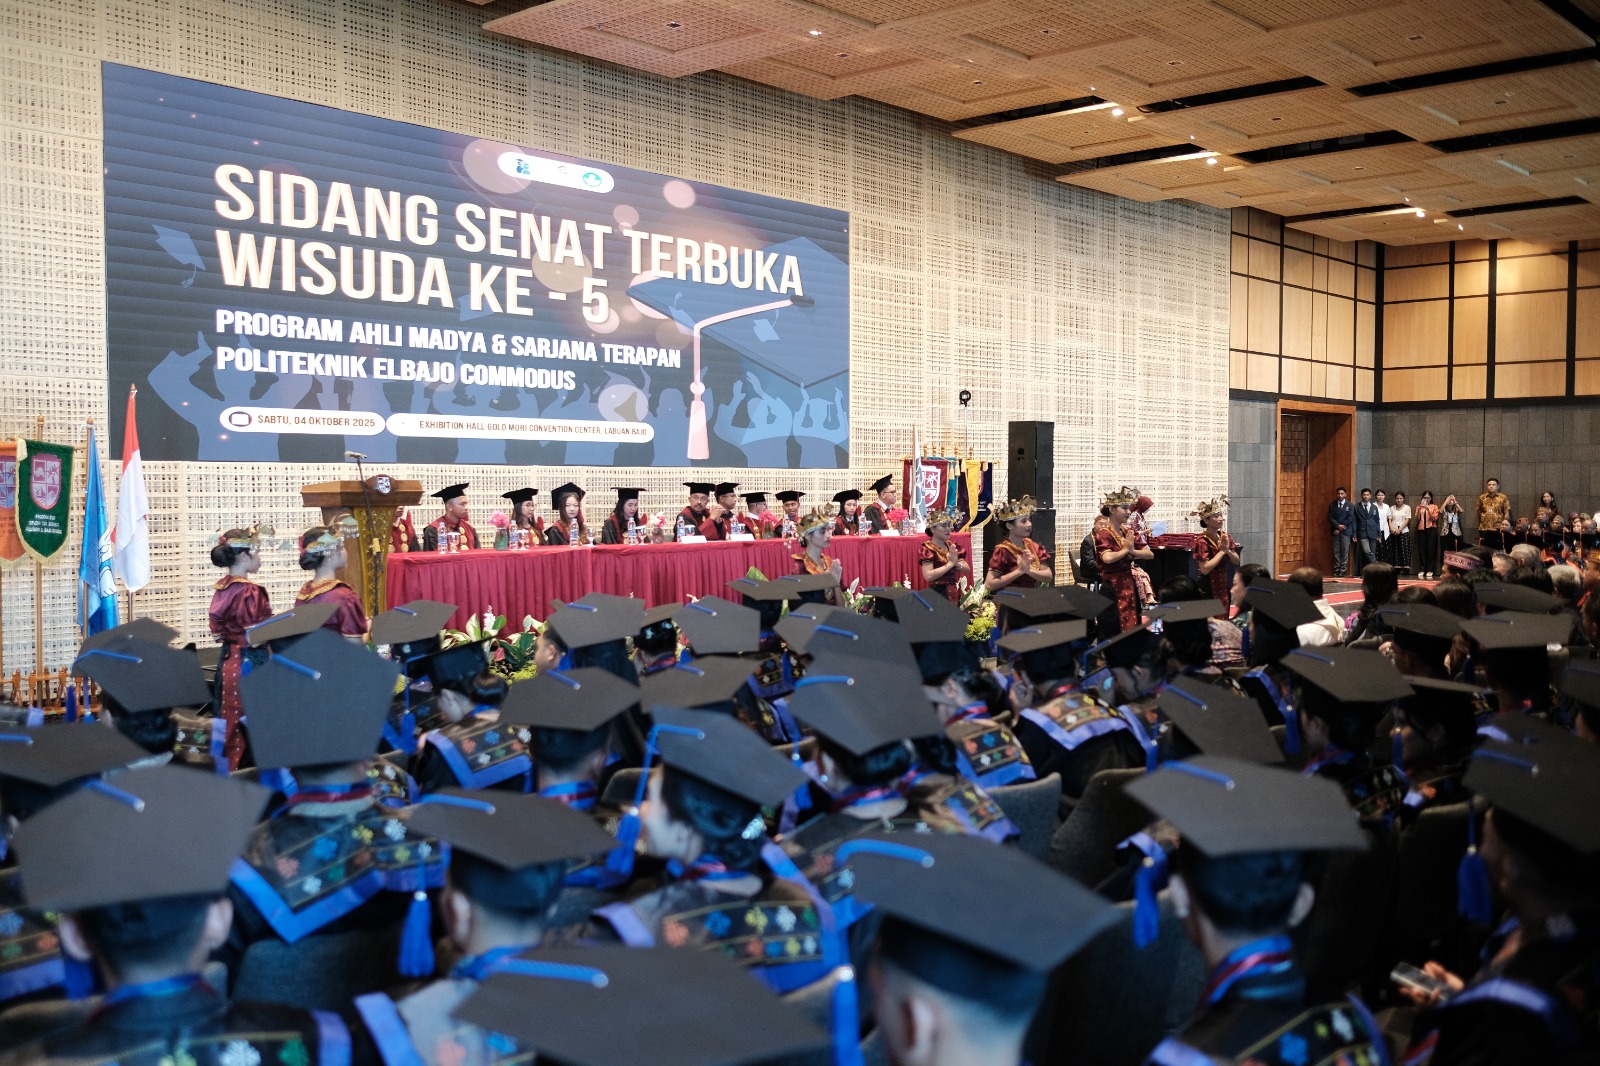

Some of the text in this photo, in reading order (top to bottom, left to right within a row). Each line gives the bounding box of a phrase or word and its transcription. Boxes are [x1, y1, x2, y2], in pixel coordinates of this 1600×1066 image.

[214, 164, 804, 296] SIDANG SENAT TERBUKA
[215, 229, 609, 324] WISUDA KE - 5
[216, 309, 681, 368] PROGRAM AHLI MADYA & SARJANA TERAPAN
[216, 346, 576, 391] POLITEKNIK ELBAJO COMMODUS
[294, 416, 307, 425] 04
[309, 417, 350, 426] OKTOBER
[353, 418, 375, 427] 2025
[419, 420, 464, 430] EXHIBITION
[467, 422, 485, 431] HALL
[487, 423, 507, 431] GOLO
[508, 424, 528, 432] MORI
[529, 424, 573, 434] CONVENTION
[604, 427, 630, 436] LABUAN
[631, 428, 648, 436] BAJO
